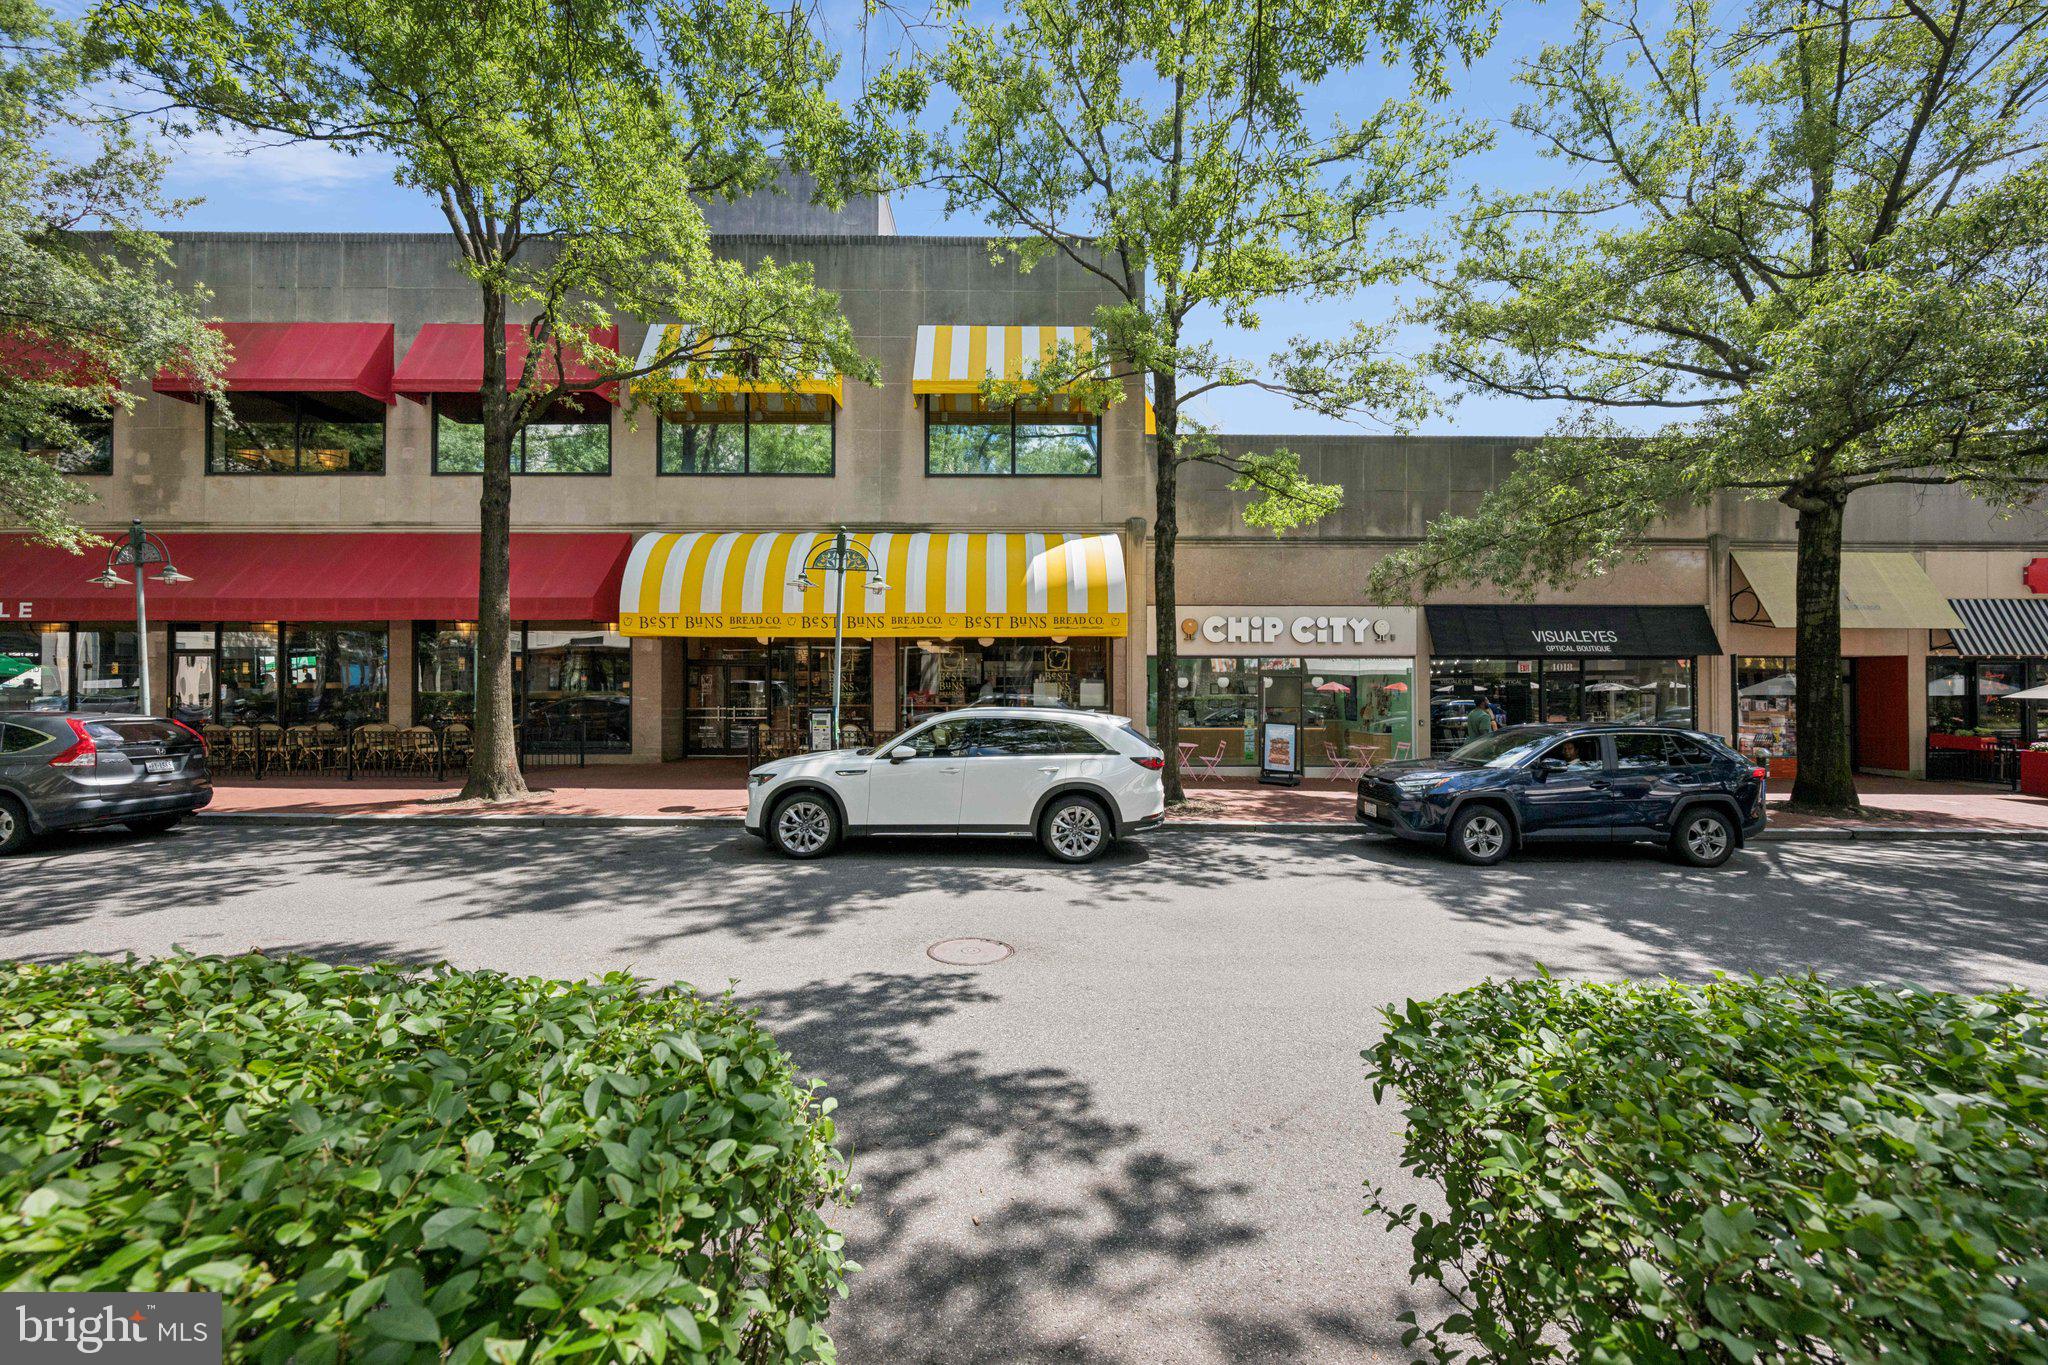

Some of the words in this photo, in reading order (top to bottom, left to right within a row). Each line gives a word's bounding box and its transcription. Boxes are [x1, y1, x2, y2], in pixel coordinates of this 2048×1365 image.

[729, 616, 763, 625] BREAD
[765, 616, 782, 625] CO.
[891, 616, 925, 625] BREAD
[926, 616, 943, 625] CO.
[1053, 616, 1087, 625] BREAD
[1088, 616, 1105, 625] CO.
[1531, 630, 1618, 643] VISUALEYES
